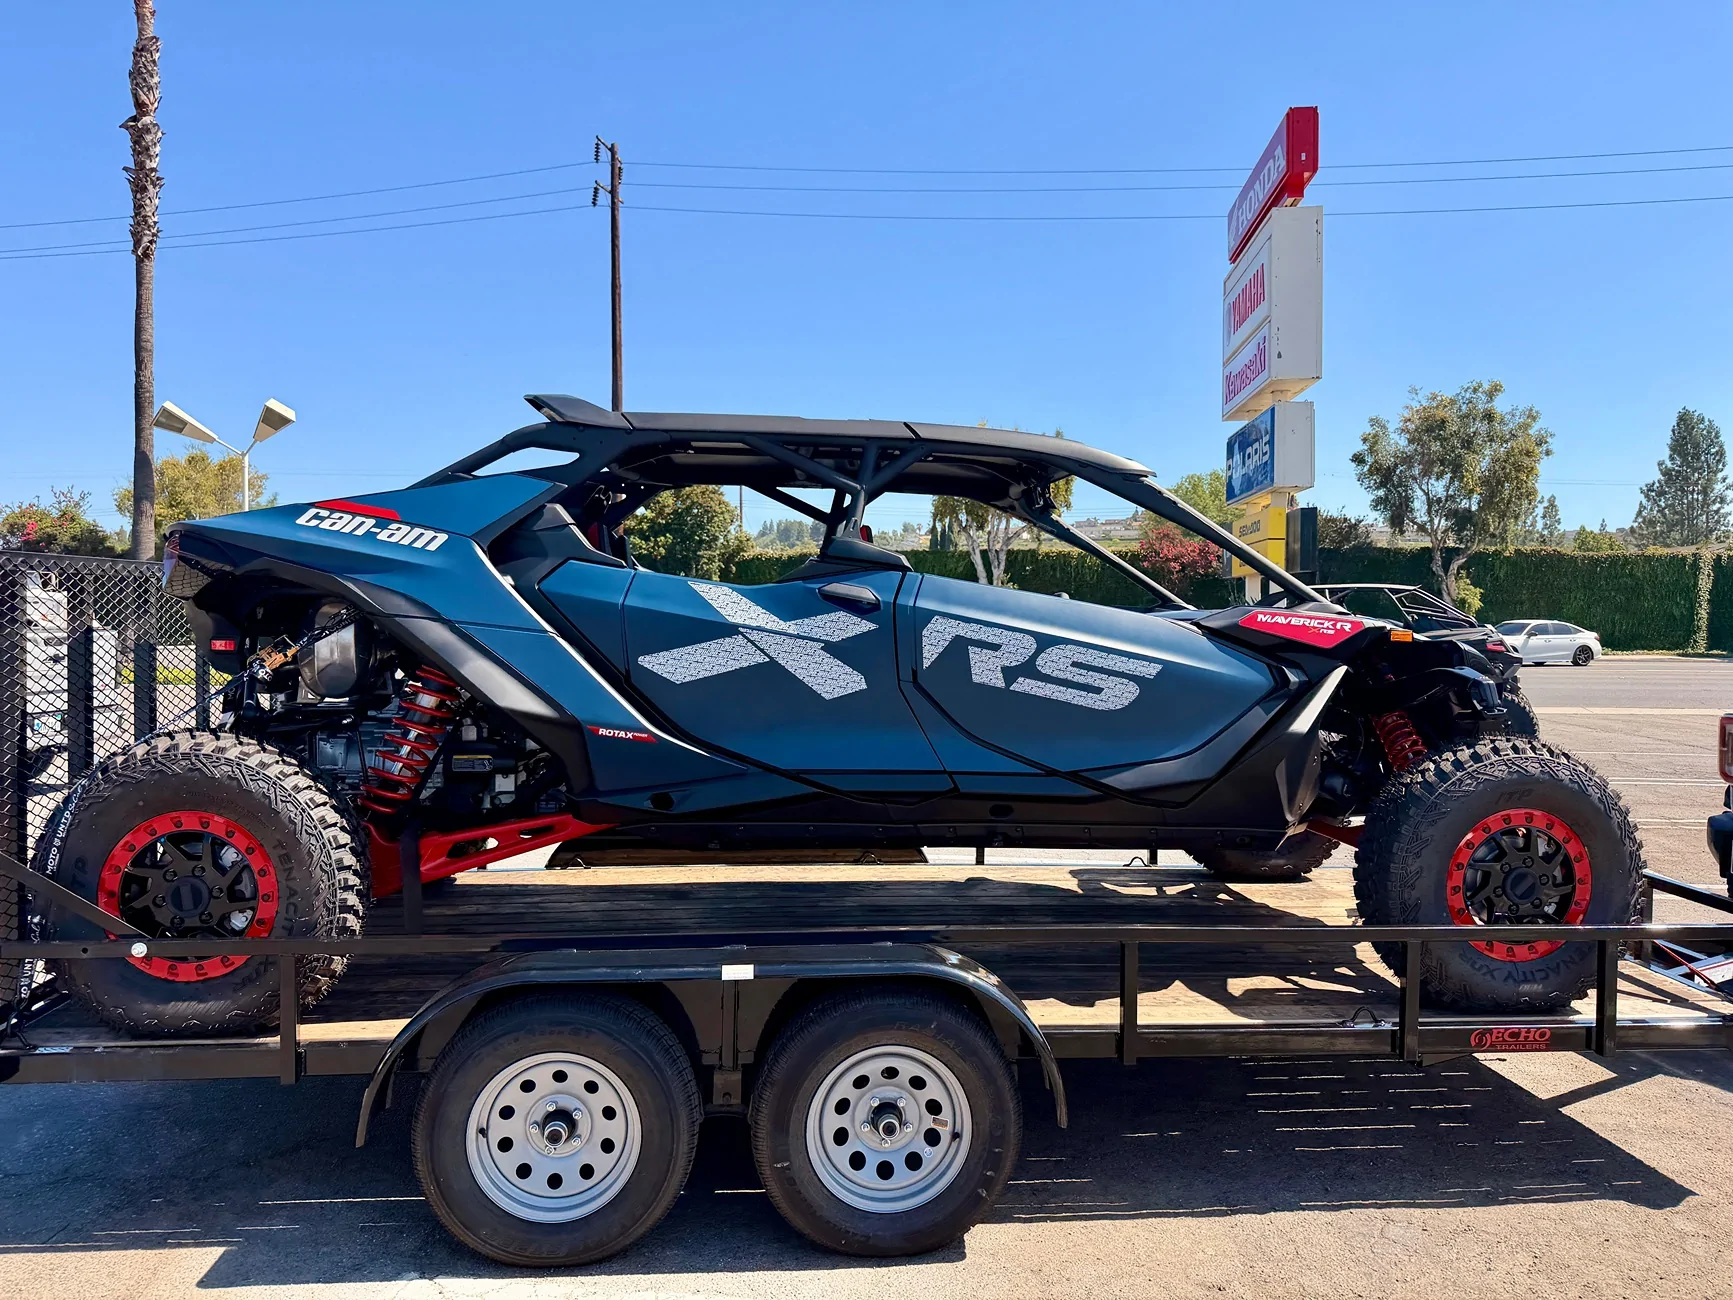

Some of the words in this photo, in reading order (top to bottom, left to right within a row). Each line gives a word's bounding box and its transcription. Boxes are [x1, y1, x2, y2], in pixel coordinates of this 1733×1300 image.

[1237, 144, 1286, 236] HONDA
[1232, 263, 1265, 335] YAMAHA
[1224, 336, 1267, 406] Kawasaki
[1226, 434, 1270, 488] POLARIS
[1256, 613, 1335, 629] MAVERICK
[1335, 621, 1351, 633] R
[598, 727, 633, 739] ROTAX
[45, 847, 58, 875] MOTO
[56, 810, 71, 837] UNTD
[272, 837, 299, 937] TENACIT
[1491, 1028, 1551, 1042] ECHO
